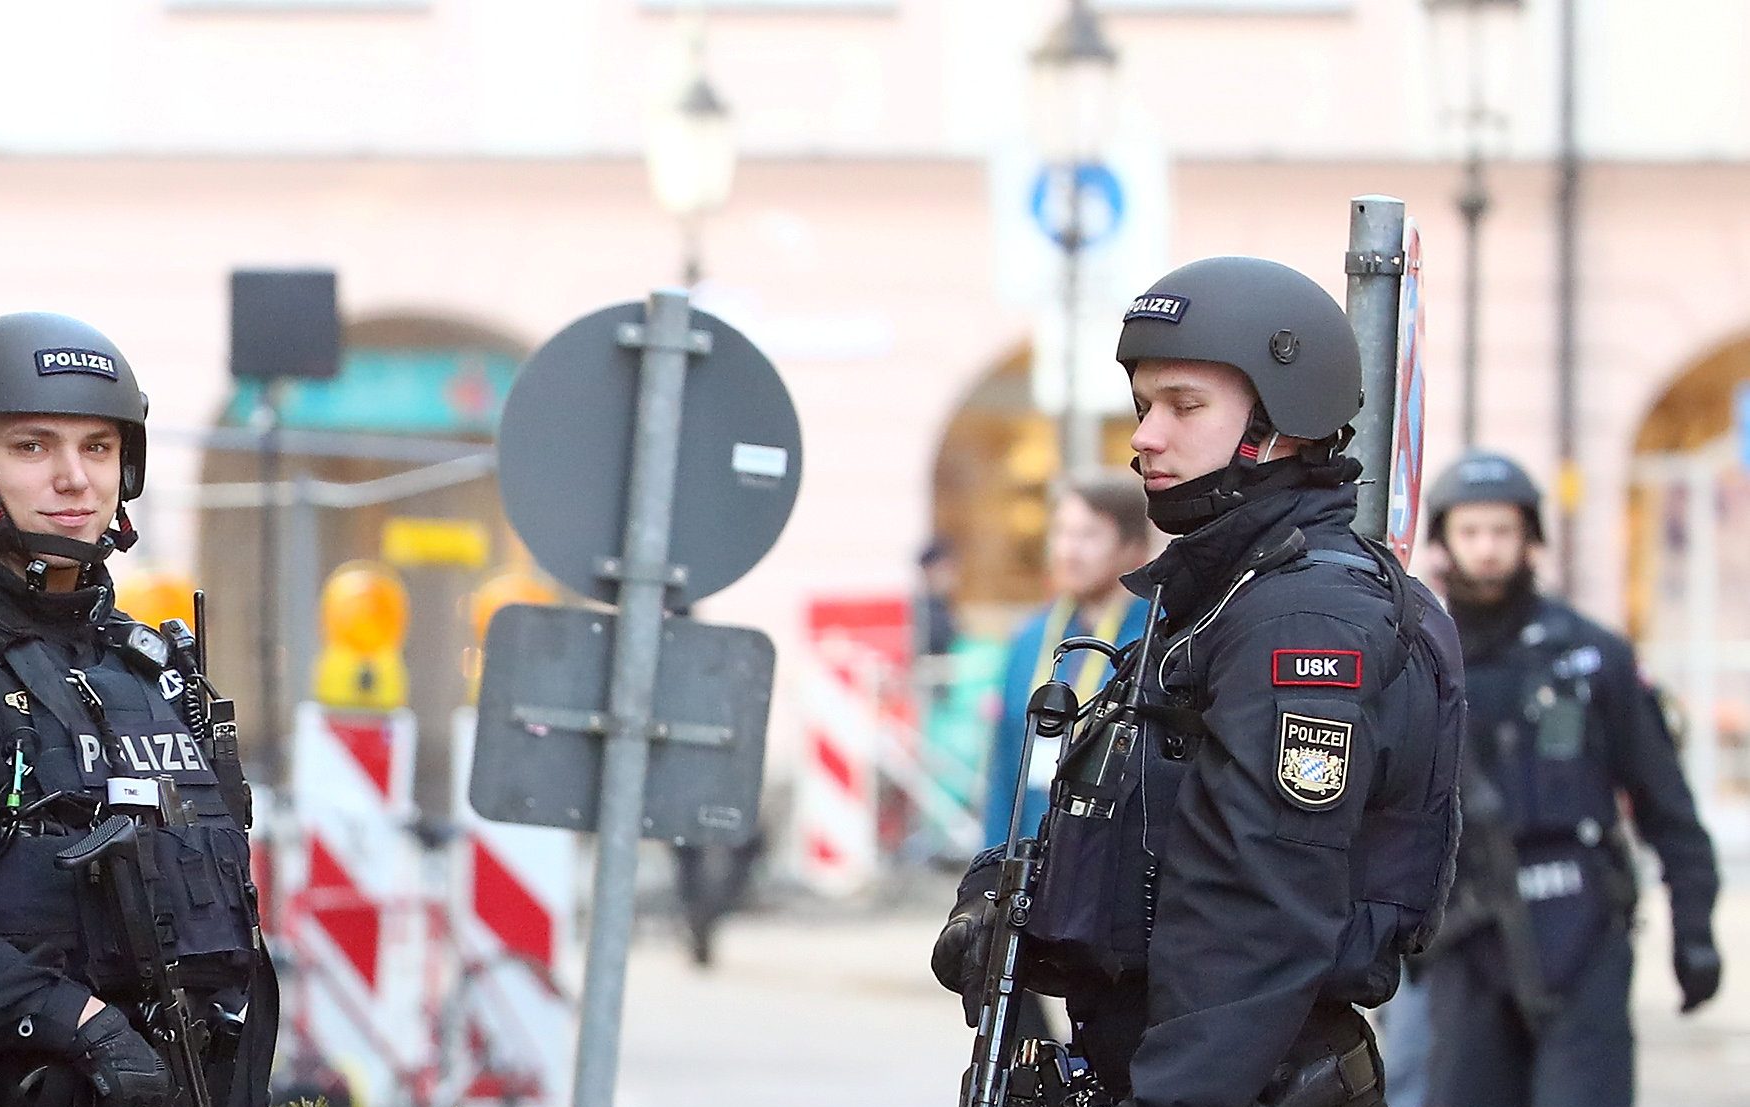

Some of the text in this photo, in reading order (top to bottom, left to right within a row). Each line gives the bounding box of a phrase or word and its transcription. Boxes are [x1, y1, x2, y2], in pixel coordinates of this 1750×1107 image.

[42, 352, 115, 373] POLIZEI
[1295, 657, 1339, 677] USK
[1288, 724, 1345, 748] POLIZEI
